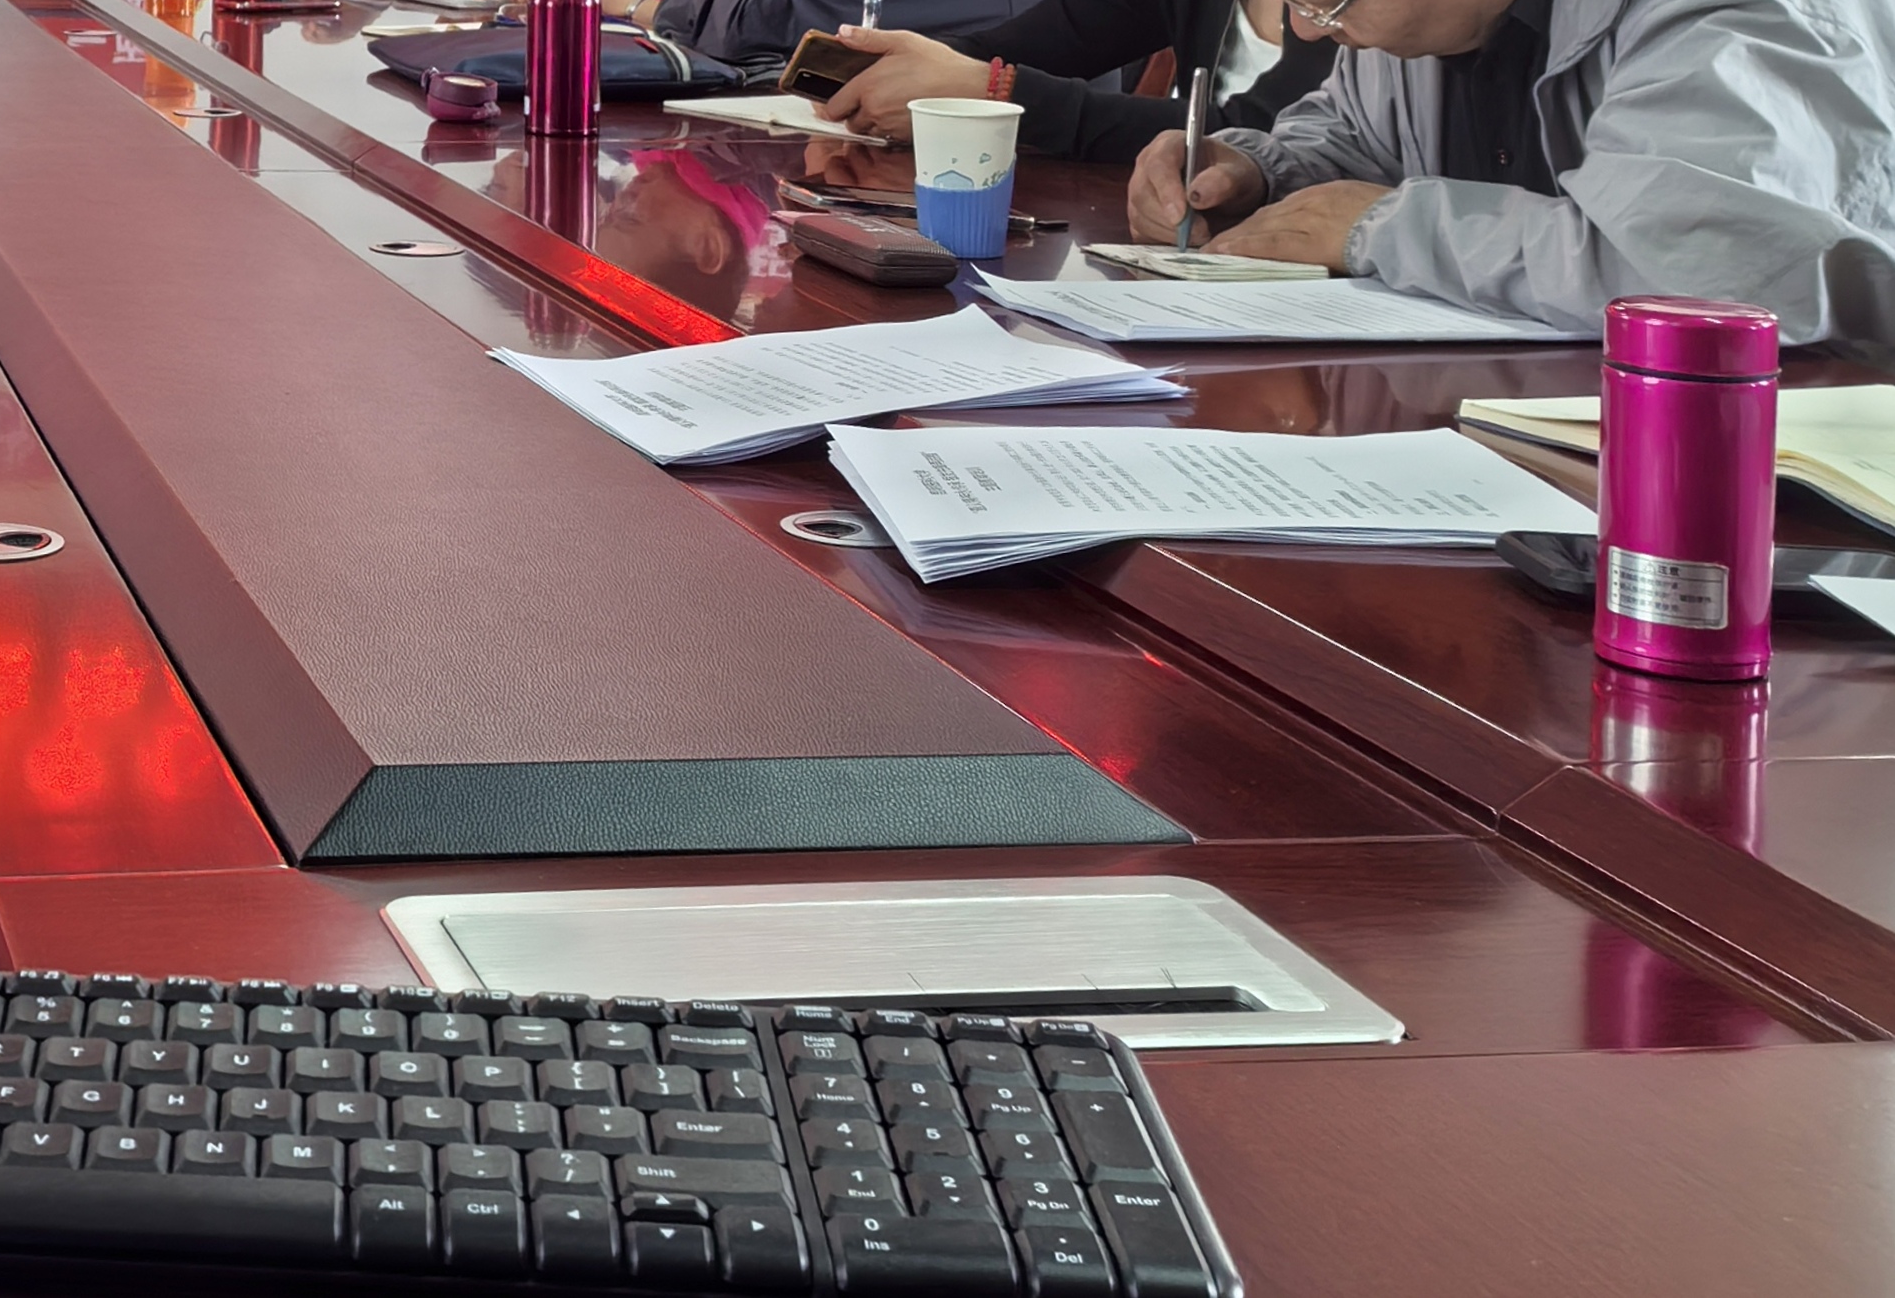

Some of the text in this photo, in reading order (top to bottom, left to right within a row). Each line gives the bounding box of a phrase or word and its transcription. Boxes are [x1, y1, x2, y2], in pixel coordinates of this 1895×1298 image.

[614, 995, 662, 1007] Insert
[690, 999, 739, 1012] Delete
[37, 1010, 50, 1022] 5
[794, 1008, 833, 1018] Home
[883, 1013, 912, 1024] End
[117, 1015, 131, 1025] 6
[199, 1017, 212, 1029] 7
[280, 1022, 294, 1033] 8
[443, 1029, 460, 1040] 0
[70, 1046, 84, 1058] T
[152, 1050, 166, 1061] Y
[233, 1054, 250, 1066] U
[322, 1059, 329, 1069] I
[399, 1061, 418, 1074] O
[484, 1066, 502, 1077] P
[824, 1076, 837, 1088] 7
[911, 1082, 926, 1094] 8
[0, 1086, 15, 1097] F
[82, 1090, 100, 1102] G
[816, 1092, 855, 1102] Home
[997, 1088, 1013, 1099] 9
[167, 1094, 185, 1105] H
[254, 1098, 268, 1110] J
[337, 1102, 355, 1113] K
[425, 1106, 441, 1119] L
[676, 1121, 723, 1133] Enter
[836, 1122, 852, 1134] 4
[33, 1133, 50, 1145] V
[925, 1128, 941, 1140] 5
[1015, 1133, 1031, 1146] 6
[119, 1137, 136, 1150] B
[206, 1142, 223, 1153] N
[293, 1146, 312, 1158] M
[637, 1166, 677, 1178] Shift
[851, 1170, 863, 1182] 1
[941, 1175, 957, 1188] 2
[1033, 1181, 1049, 1194] 3
[847, 1188, 876, 1198] End
[379, 1199, 404, 1210] Alt
[1114, 1194, 1161, 1206] Enter
[466, 1203, 499, 1214] Ctrl
[864, 1218, 880, 1231] 0
[863, 1238, 891, 1251] Ins
[1054, 1251, 1084, 1264] Del
